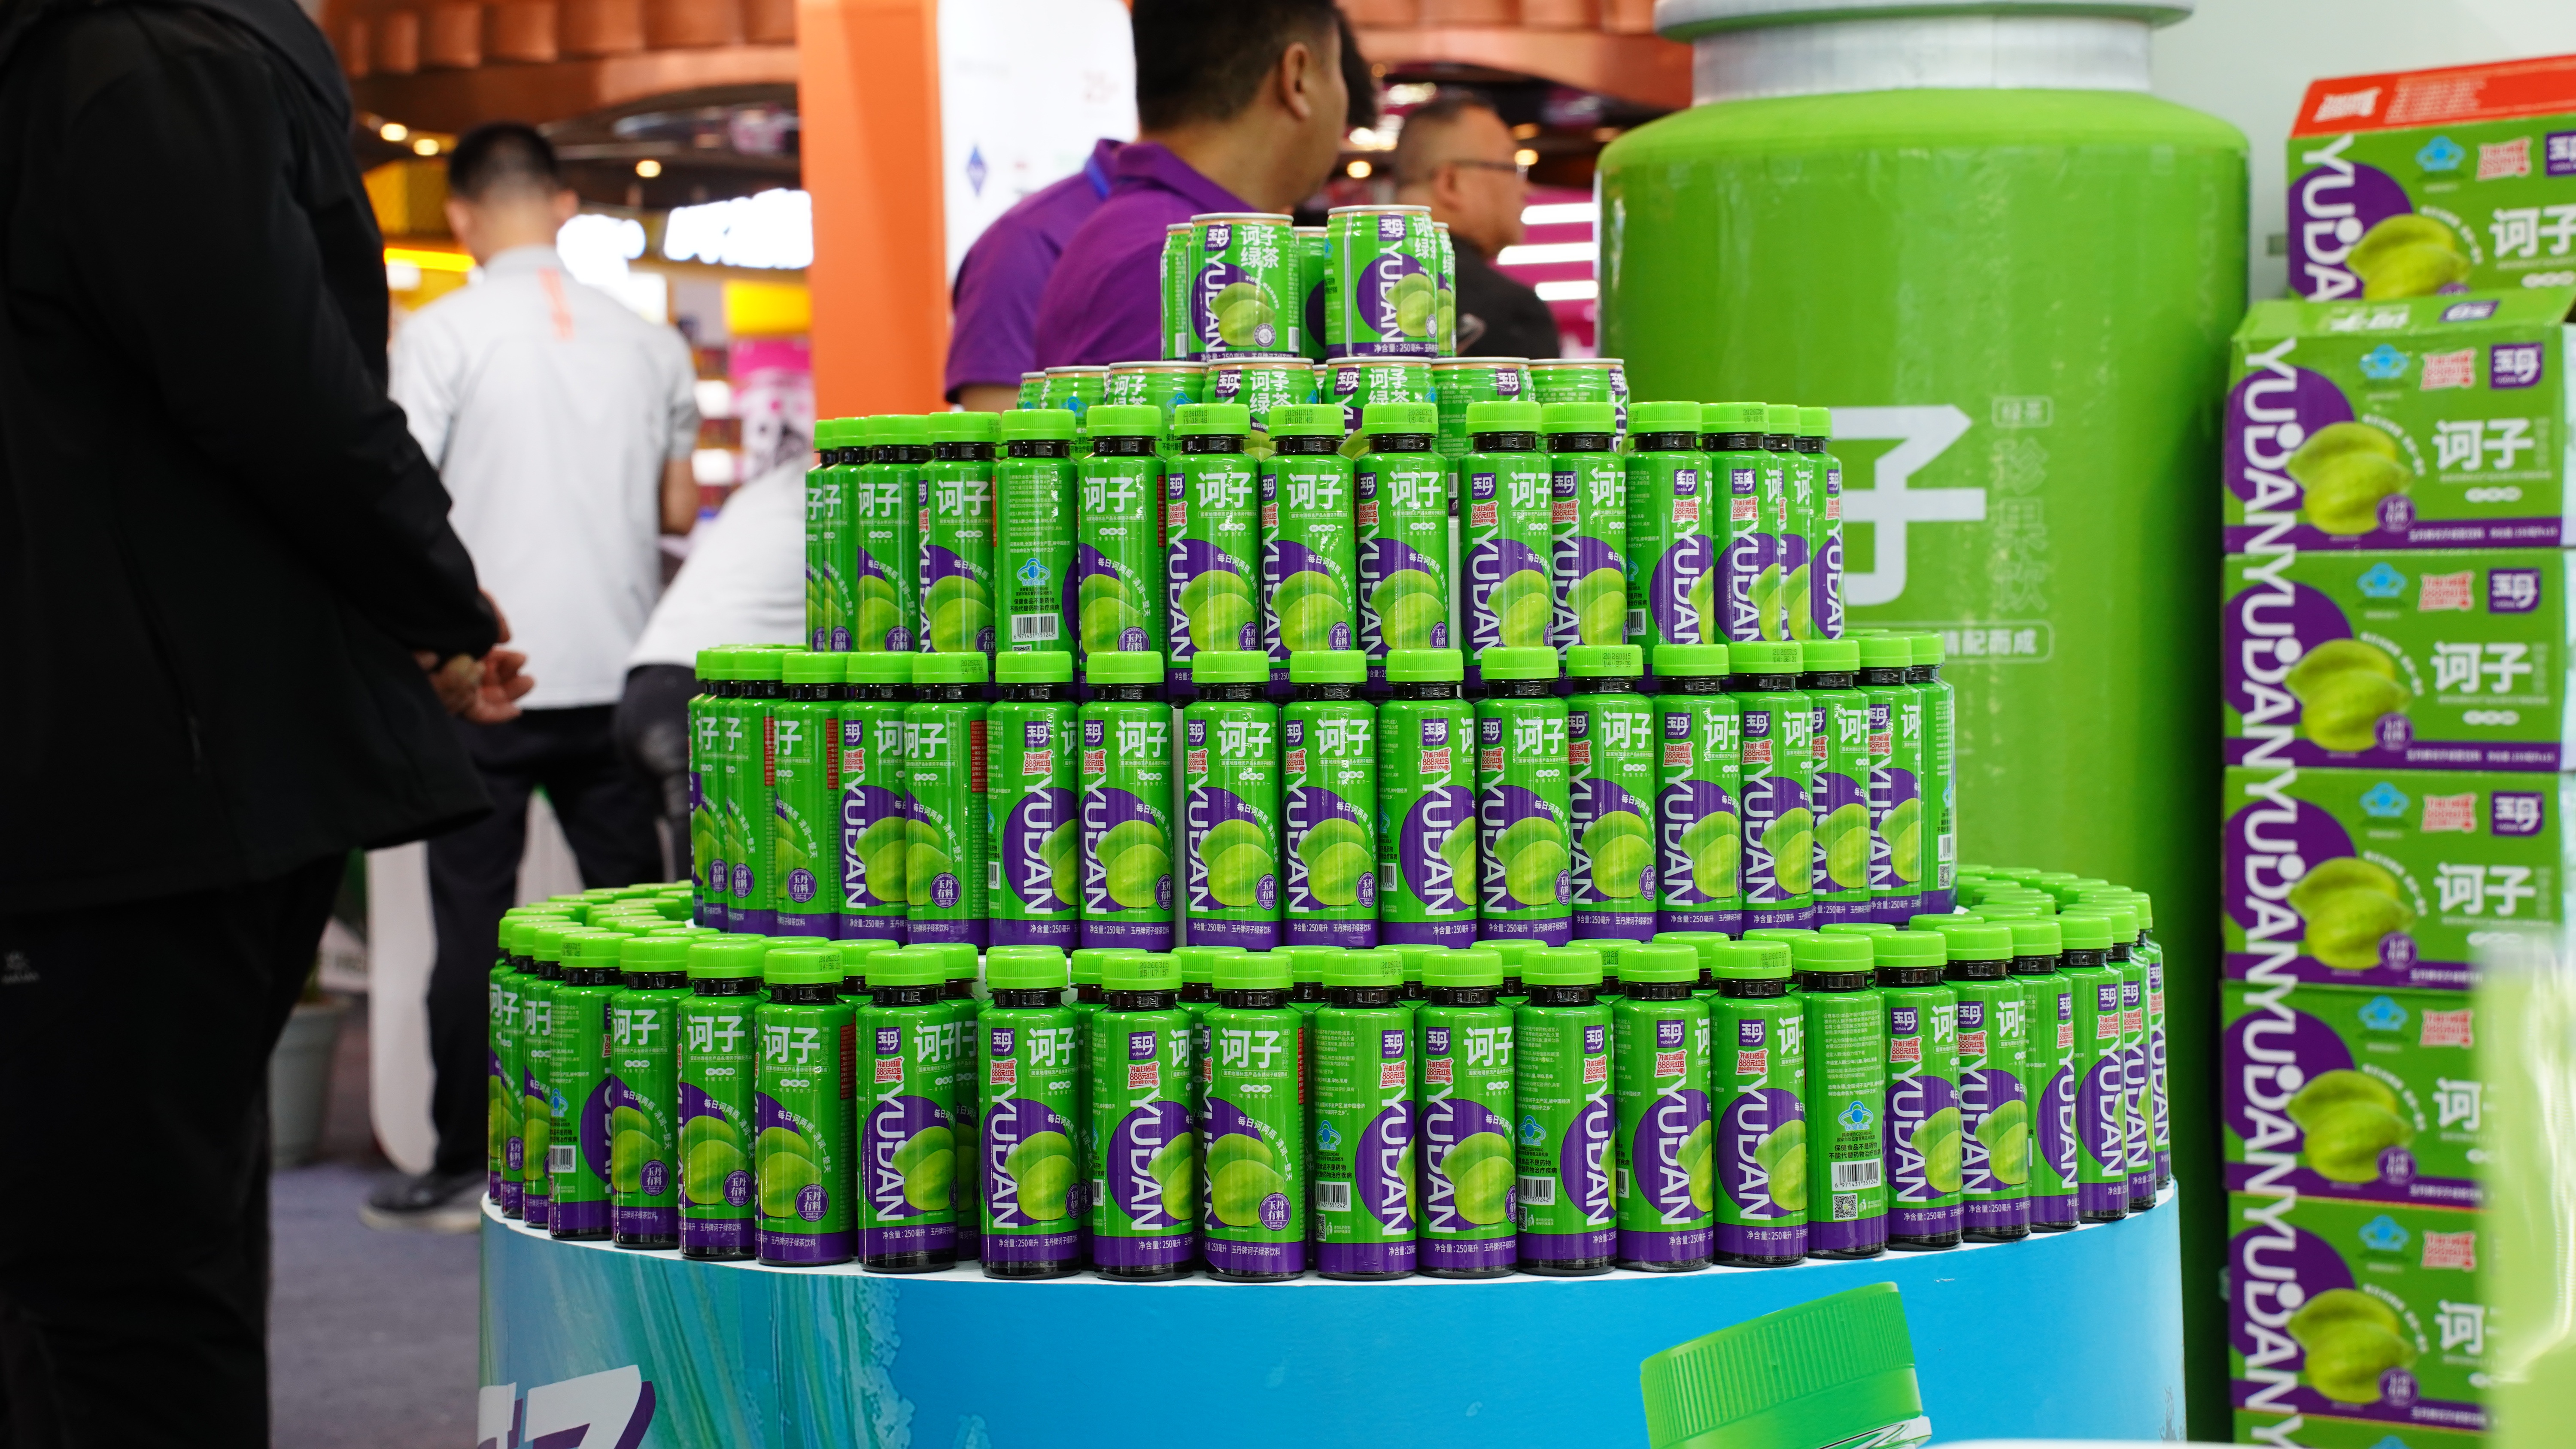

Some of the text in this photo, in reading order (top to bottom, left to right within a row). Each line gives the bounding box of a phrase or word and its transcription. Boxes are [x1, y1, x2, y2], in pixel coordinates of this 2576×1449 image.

[1240, 225, 1277, 246] 诃子
[1415, 237, 1437, 259] 绿茶
[1240, 246, 1279, 268] 绿茶
[1205, 250, 1226, 352] YUDAN
[1379, 240, 1404, 342] YUDAN
[1374, 344, 1420, 352] 净含量:250毫升
[1115, 375, 1147, 396] 诃子
[1250, 371, 1289, 391] 诃子
[1369, 368, 1407, 389] 诃子
[2242, 338, 2304, 554] YUDAN
[2432, 417, 2535, 471] 诃子
[936, 479, 990, 516] 诃子
[1084, 476, 1136, 515] 诃子
[1196, 472, 1252, 509] 诃子
[1287, 473, 1342, 510] 诃子
[1388, 471, 1441, 508] 诃子
[1508, 471, 1550, 508] 诃子
[1832, 404, 1986, 606] 子
[1098, 558, 1133, 579] 每日诃两瓶
[1218, 553, 1250, 574] 每日诃两瓶
[1732, 524, 1759, 641] YUDAN
[1169, 529, 1191, 661] YUDAN
[1262, 527, 1280, 662] YUDAN
[1359, 525, 1382, 659] YUDAN
[1674, 527, 1699, 644] YUDAN
[1336, 628, 1351, 637] 玉丹
[1336, 637, 1351, 646] 有料
[2242, 552, 2303, 767] YUDAN
[2430, 641, 2532, 694] 诃子
[1116, 719, 1167, 758] 诃子
[1217, 719, 1271, 758] 诃子
[1315, 718, 1370, 756] 诃子
[1514, 718, 1564, 754] 诃子
[1601, 711, 1651, 749] 诃子
[1237, 803, 1267, 824] 每日诃两瓶
[1337, 802, 1368, 822] 每日诃两瓶
[843, 774, 866, 909] YUDAN
[943, 823, 962, 862] 清润一整天
[1024, 775, 1052, 914] YUDAN
[1084, 775, 1106, 914] YUDAN
[1189, 775, 1208, 912] YUDAN
[1287, 775, 1309, 913] YUDAN
[1423, 775, 1454, 915] YUDAN
[1482, 773, 1507, 913] YUDAN
[1571, 770, 1592, 904] YUDAN
[1664, 765, 1693, 906] YUDAN
[1744, 764, 1775, 904] YUDAN
[793, 875, 808, 884] 玉丹
[938, 879, 954, 888] 玉丹
[938, 888, 954, 898] 有料
[2244, 768, 2306, 985] YUDAN
[2434, 862, 2536, 916] 诃子
[1030, 924, 1070, 934] 净含量:250毫升
[1090, 925, 1126, 935] 净含量:250毫升
[1193, 923, 1226, 932] 净含量:250毫升
[1293, 924, 1327, 933] 净含量:250毫升
[1433, 925, 1468, 935] 净含量:250毫升
[613, 1009, 659, 1046] 诃子
[687, 1015, 745, 1053] 诃子
[763, 1024, 820, 1064] 诃子
[1464, 1027, 1513, 1066] 诃子
[1027, 1027, 1075, 1067] 诃子
[1169, 1029, 1190, 1068] 诃
[1219, 1027, 1281, 1069] 诃子
[623, 1090, 655, 1111] 每日诃两瓶
[2242, 983, 2304, 1194] YUDAN
[1238, 1116, 1276, 1139] 每日诃两瓶
[2099, 1040, 2123, 1177] YUDAN
[778, 1110, 832, 1173] 每日诃两瓶 清润一整天
[1657, 1079, 1690, 1224] YUDAN
[1738, 1078, 1771, 1220] YUDAN
[1835, 1143, 1877, 1151] 保健食品不是药物
[1893, 1064, 1927, 1202] YUDAN
[648, 1167, 661, 1176] 玉丹
[876, 1084, 904, 1221] YUDAN
[991, 1084, 1018, 1228] YUDAN
[1130, 1087, 1162, 1230] YUDAN
[1382, 1088, 1407, 1235] YUDAN
[1426, 1087, 1456, 1233] YUDAN
[1586, 1084, 1609, 1225] YUDAN
[1829, 1149, 1881, 1159] 不能代替药物治疗疾病
[1267, 1200, 1285, 1210] 玉丹
[1267, 1210, 1285, 1220] 有料
[1904, 1209, 1947, 1221] 净含量:250毫升
[1969, 1202, 2011, 1213] 净含量:250毫升
[771, 1237, 816, 1247] 玉丹牌诃子绿茶饮料
[882, 1228, 925, 1239] 净含量:250毫升
[1232, 1246, 1280, 1256] 玉丹牌诃子绿茶饮料
[1434, 1243, 1479, 1253] 净含量:250毫升
[1669, 1233, 1706, 1246] 净含量:250毫升
[1747, 1230, 1792, 1240] 净含量:250毫升
[2243, 1195, 2305, 1413] YUDAN
